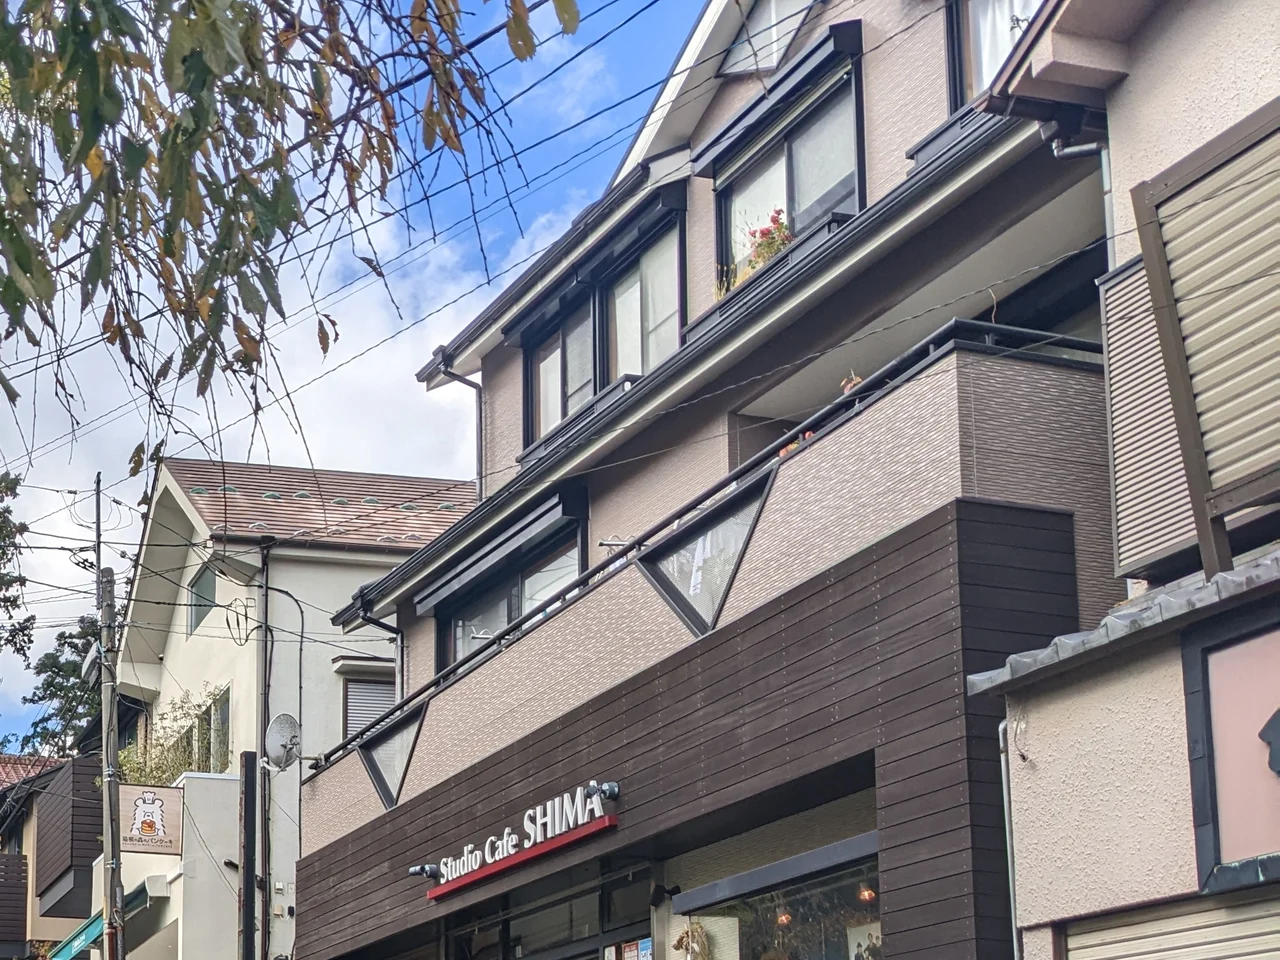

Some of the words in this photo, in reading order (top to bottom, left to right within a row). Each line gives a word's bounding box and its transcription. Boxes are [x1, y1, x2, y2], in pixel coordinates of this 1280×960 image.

[439, 843, 482, 884] Studio
[484, 827, 518, 864] Cafe
[523, 780, 605, 848] SHIMA
